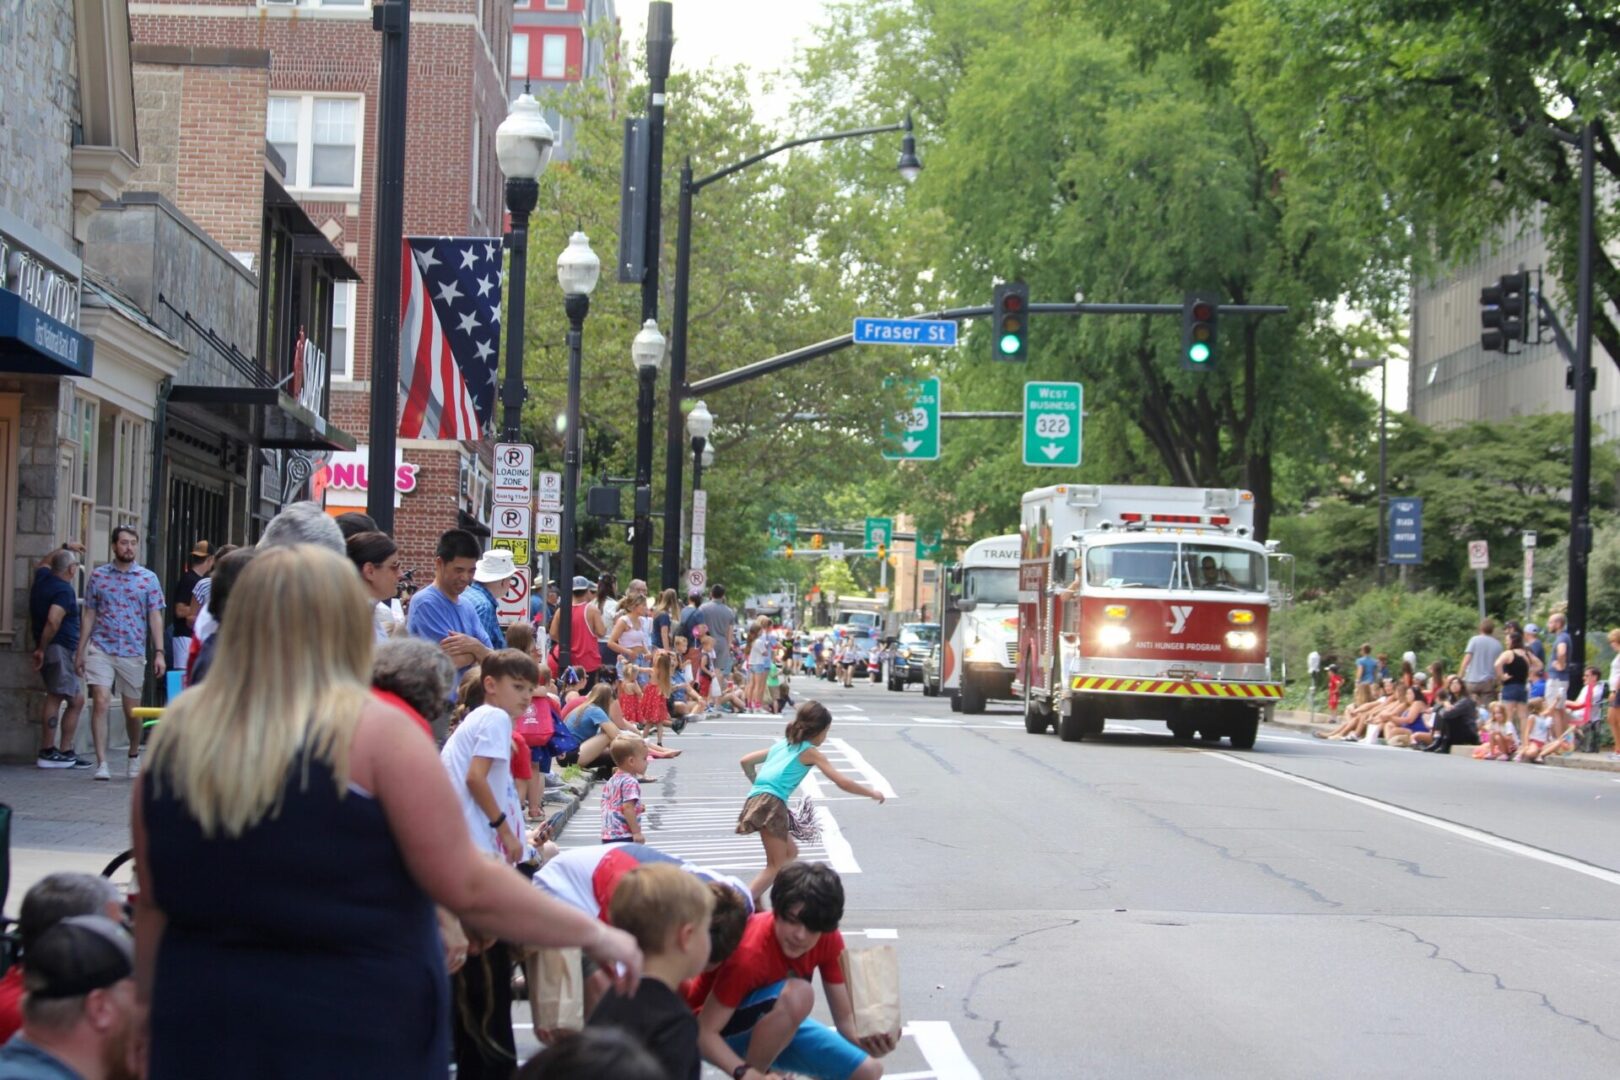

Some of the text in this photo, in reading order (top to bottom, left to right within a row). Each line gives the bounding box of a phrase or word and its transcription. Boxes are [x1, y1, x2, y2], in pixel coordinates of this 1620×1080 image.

[865, 323, 945, 341] Fraser St
[1039, 419, 1066, 432] 322
[1136, 641, 1221, 651] ANTI HUNGER PROGRAM
